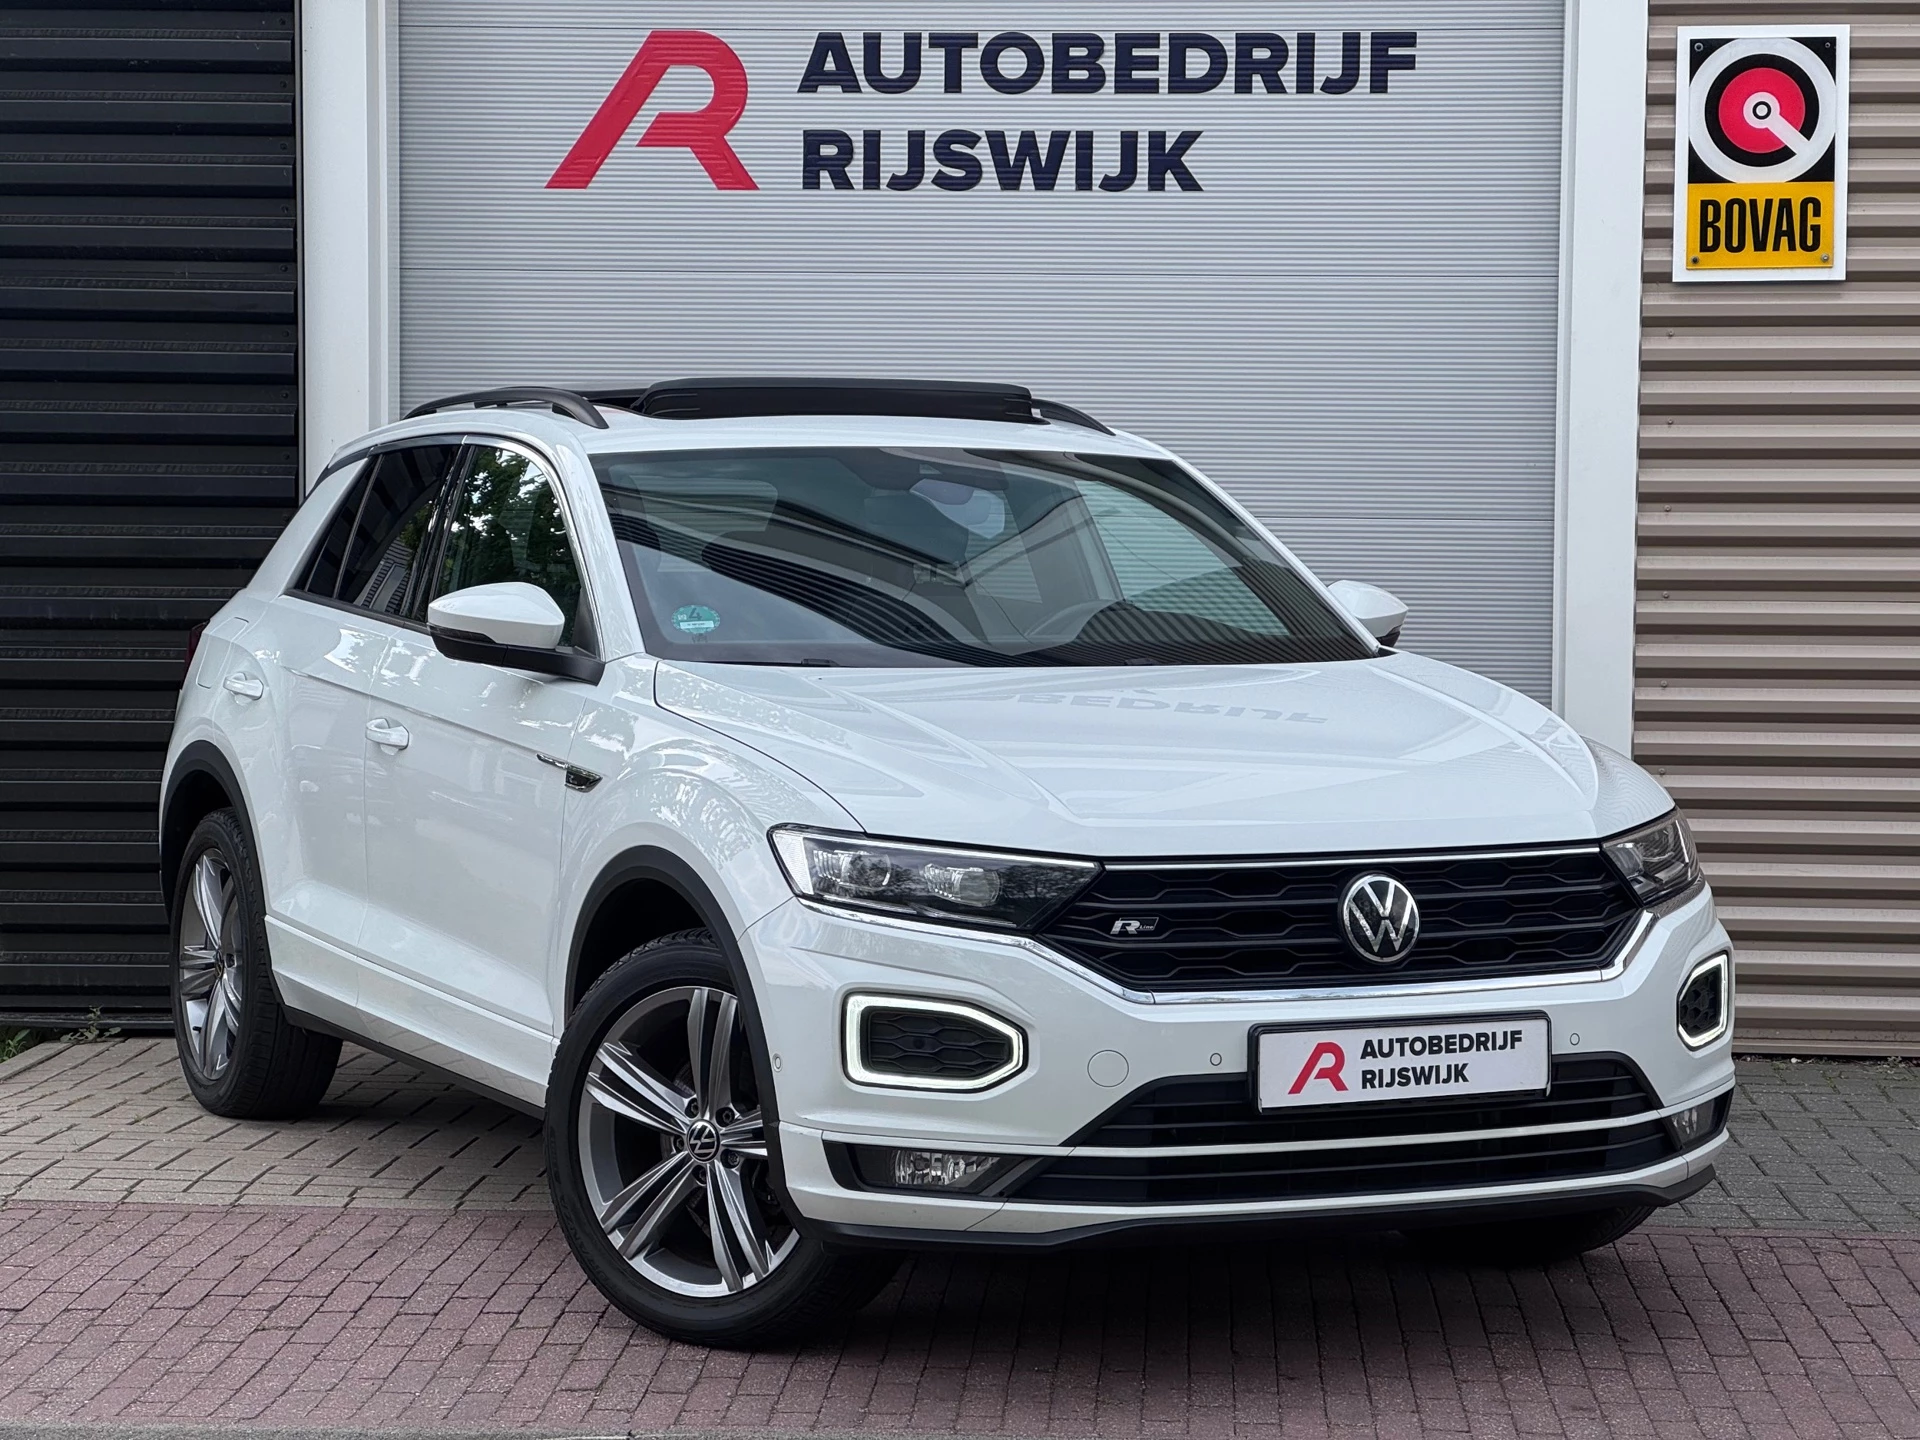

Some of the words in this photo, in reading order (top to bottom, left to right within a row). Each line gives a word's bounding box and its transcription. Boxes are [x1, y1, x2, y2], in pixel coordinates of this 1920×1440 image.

[797, 32, 1417, 95] AUTOBEDRIJF
[801, 129, 1204, 192] RIJSWIJK
[1699, 197, 1821, 253] BOVAG
[688, 607, 703, 621] 4
[1360, 1030, 1523, 1060] AUTOBEDRIJF
[1361, 1063, 1469, 1090] RIJSWIJK
